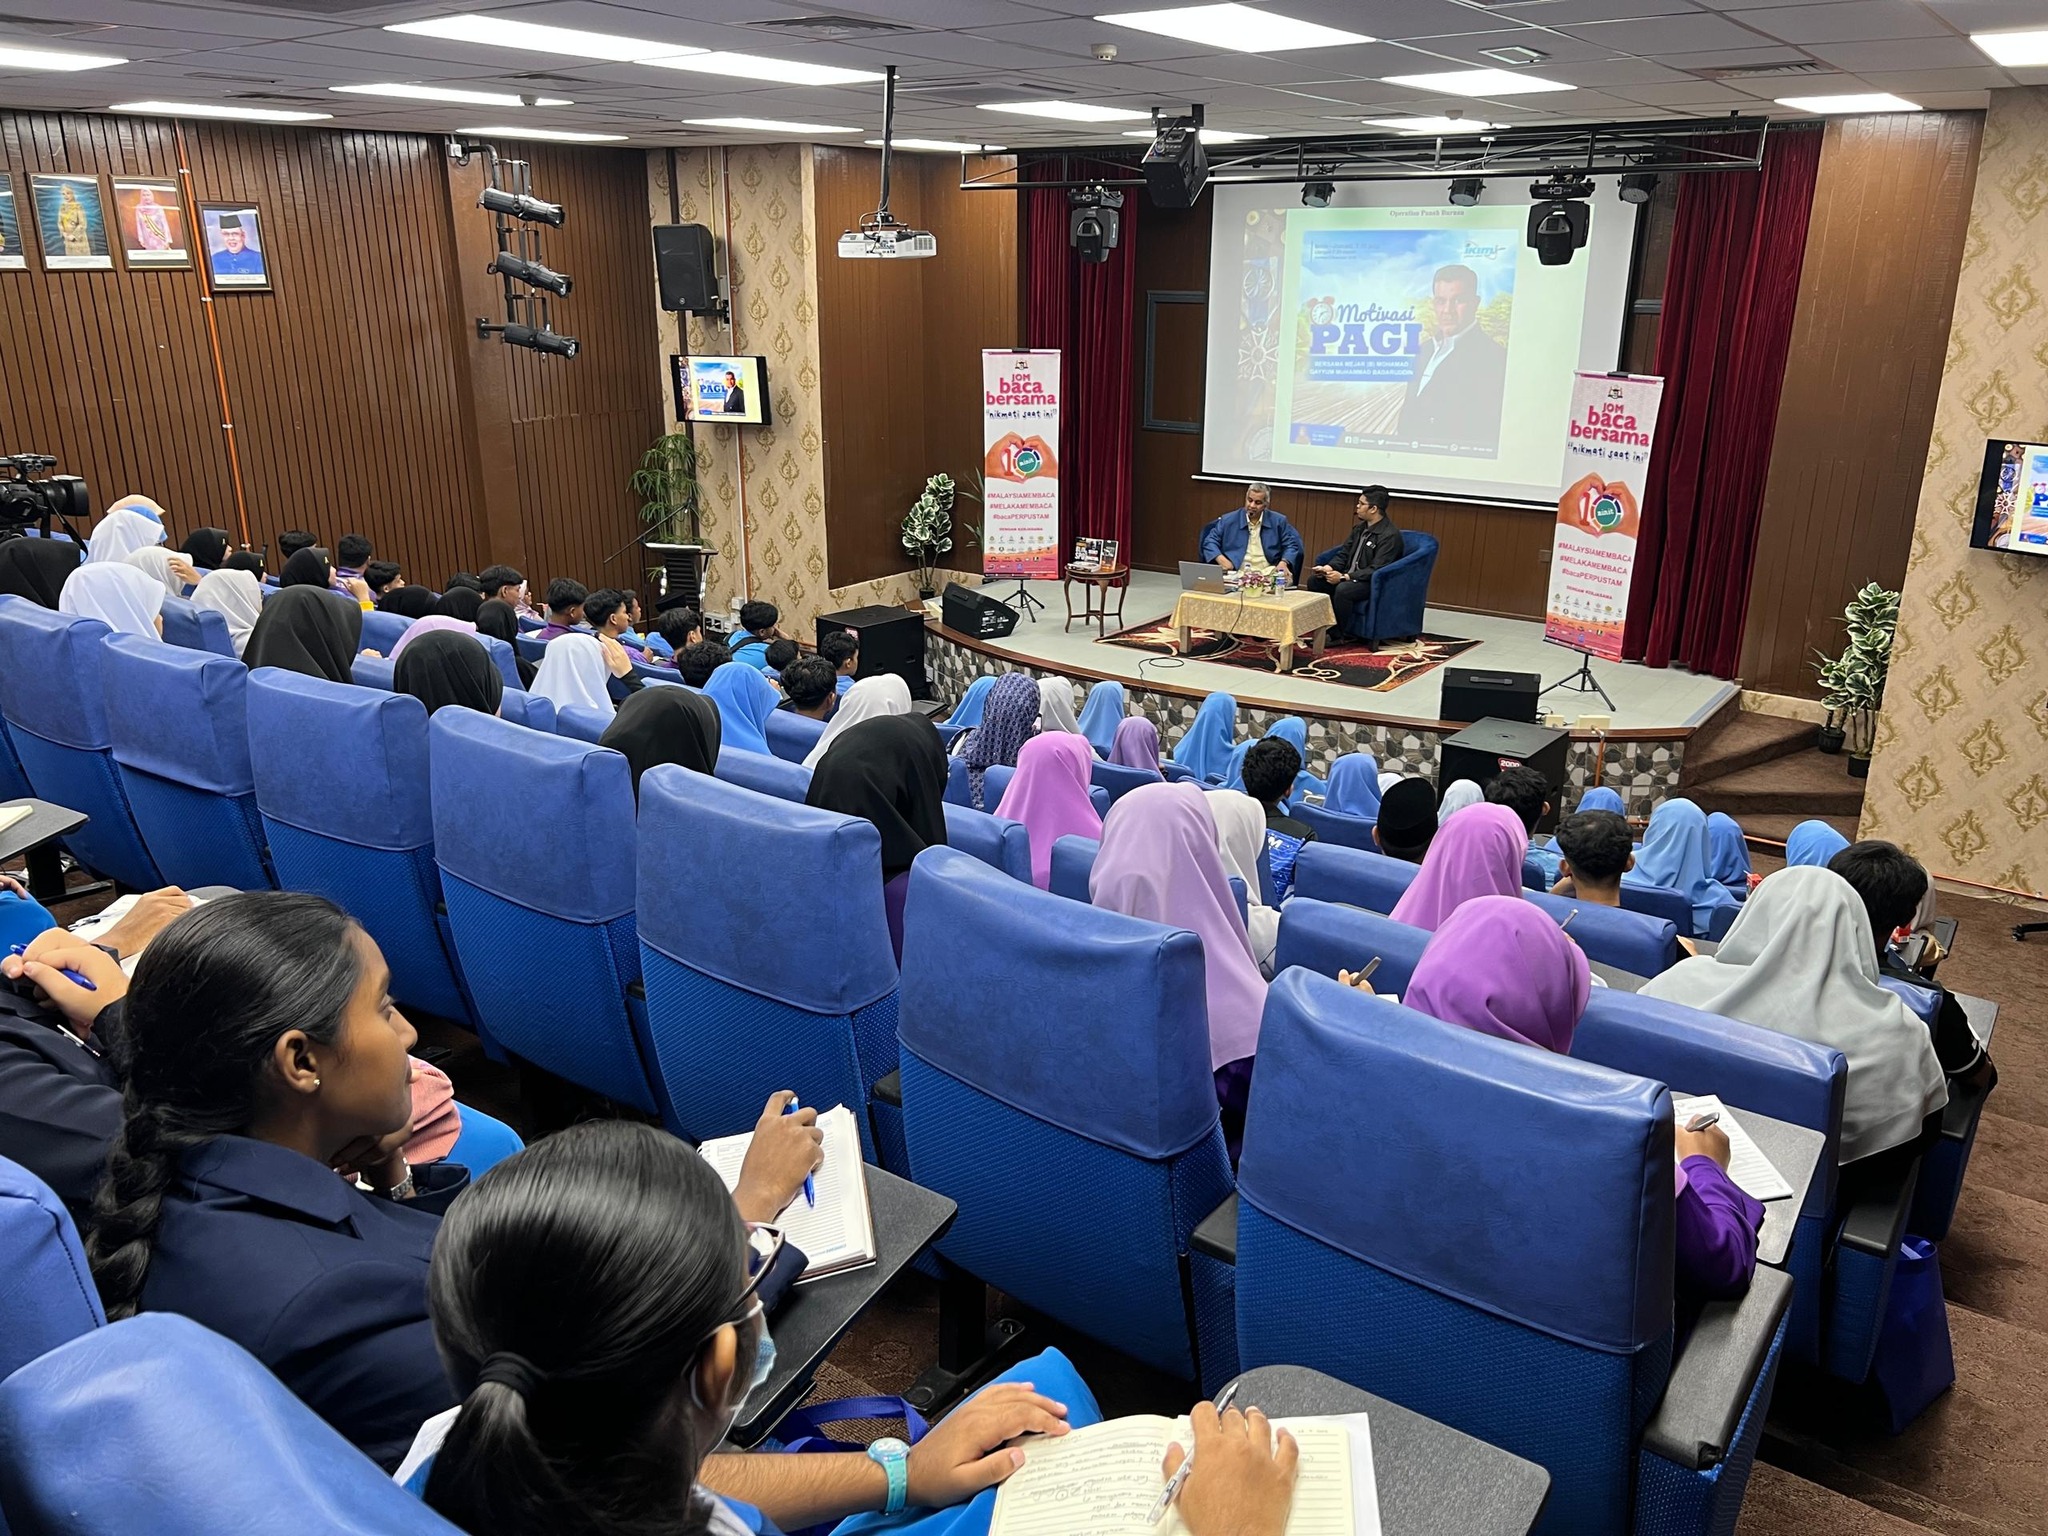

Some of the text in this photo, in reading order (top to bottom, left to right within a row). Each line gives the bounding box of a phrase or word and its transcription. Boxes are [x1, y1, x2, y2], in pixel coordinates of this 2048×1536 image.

[1338, 302, 1416, 323] Motivasi
[1310, 323, 1423, 354] PAGI
[1000, 378, 1044, 394] baca
[1012, 374, 1030, 382] JOM
[986, 391, 1057, 406] bersama
[1602, 402, 1624, 414] JOM
[1588, 405, 1637, 430] baca
[1570, 420, 1650, 447] bersama
[1608, 450, 1630, 460] saat
[1558, 542, 1632, 562] #MALAYSIAMEMBACA
[1560, 555, 1628, 574] #MELAKAMEMBACA
[1562, 568, 1622, 586] #bacaPERPUSTAM
